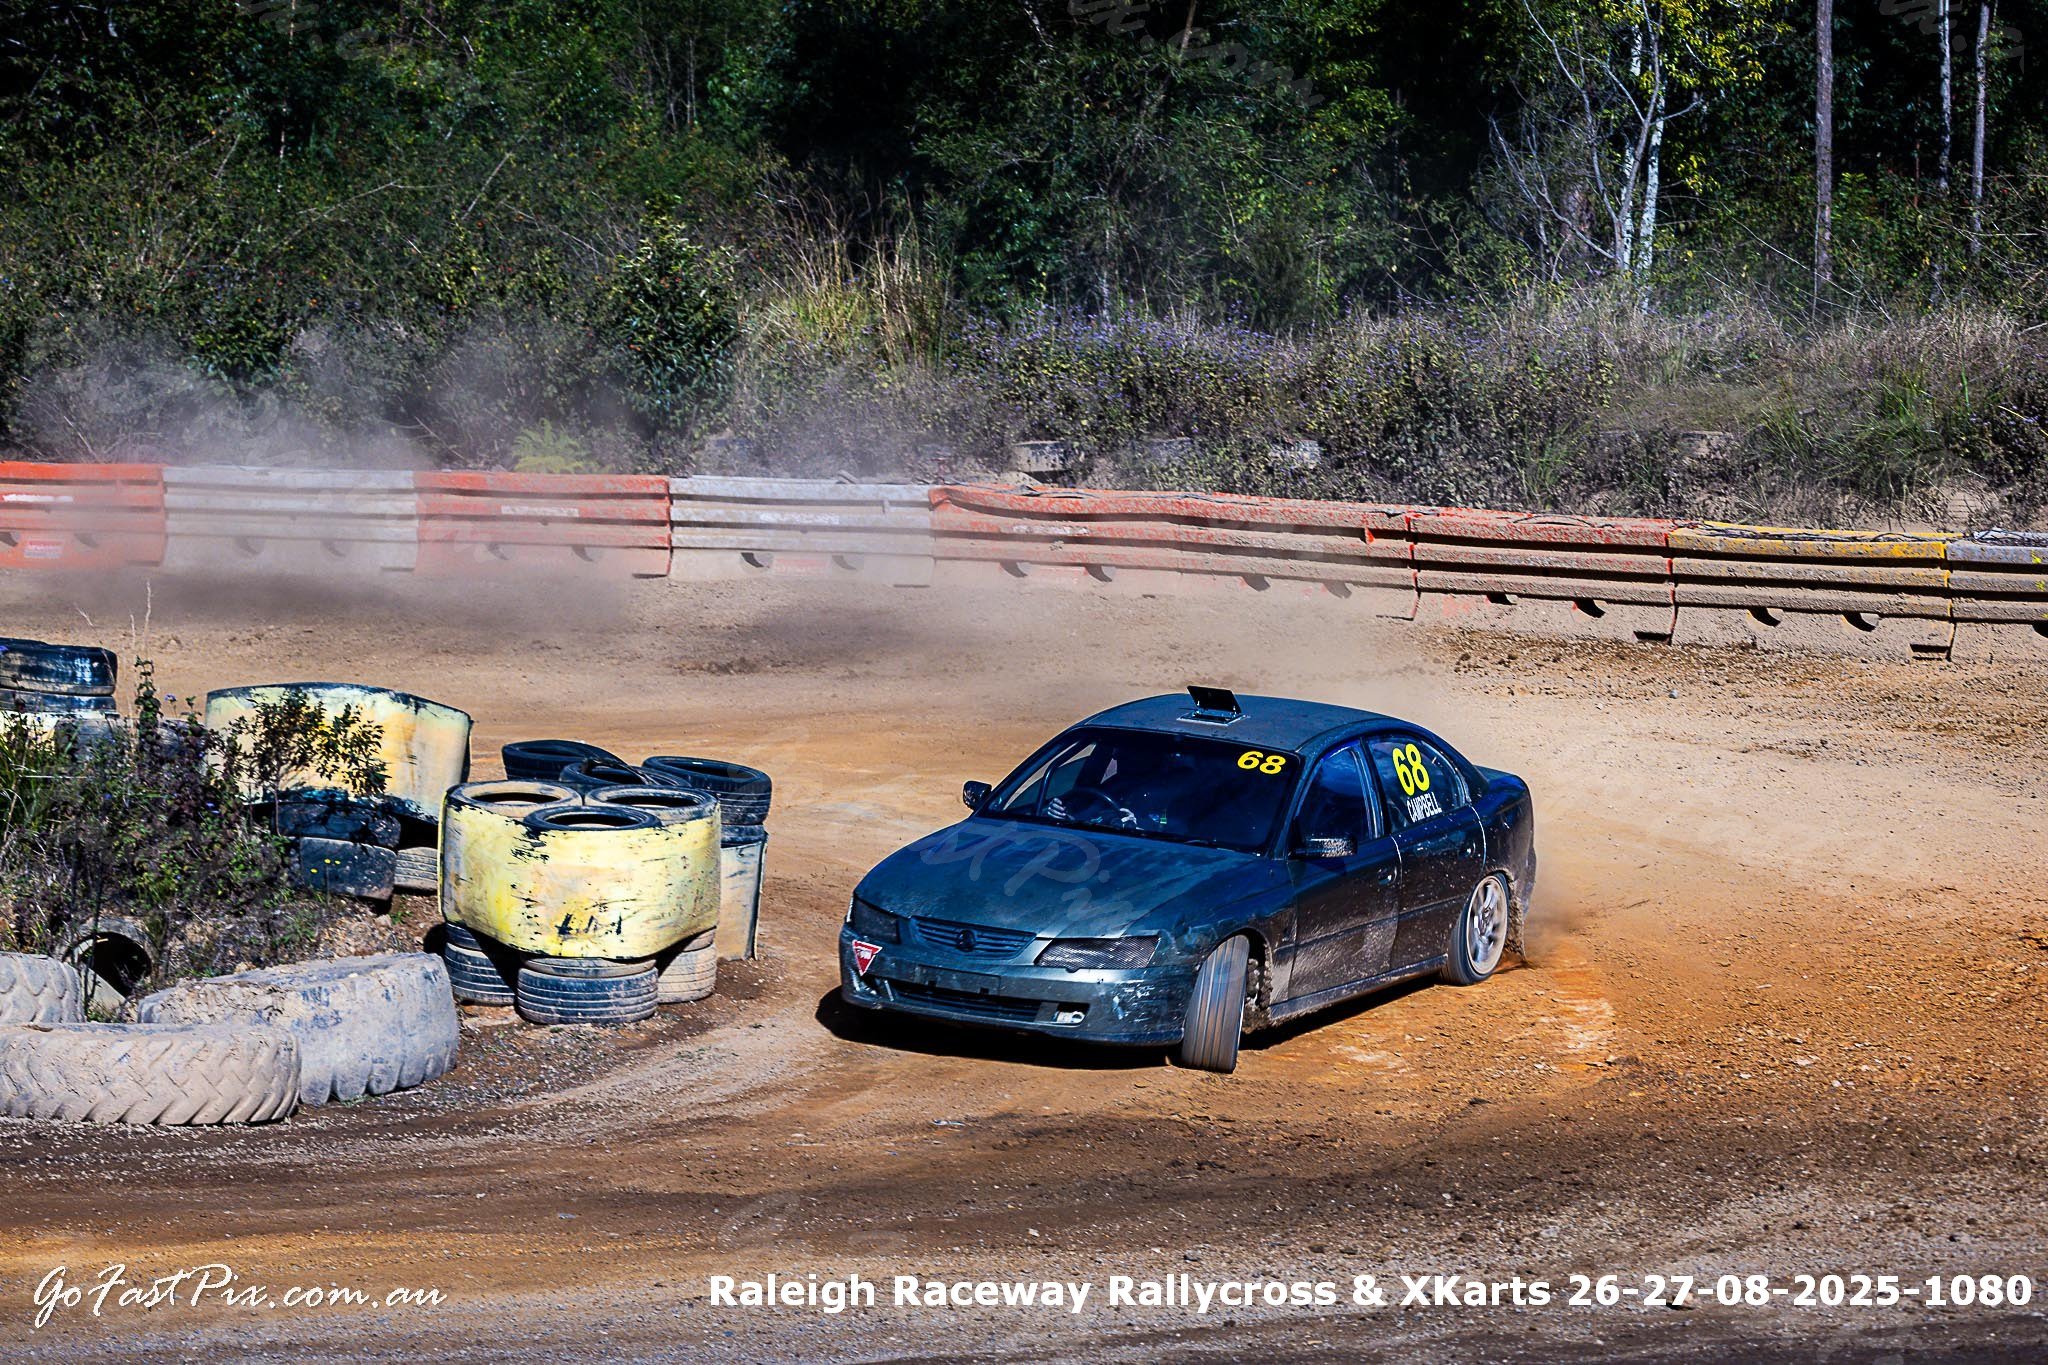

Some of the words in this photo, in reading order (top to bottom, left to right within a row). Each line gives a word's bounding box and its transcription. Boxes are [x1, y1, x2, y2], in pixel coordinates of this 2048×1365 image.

[1237, 751, 1286, 775] 68
[1392, 743, 1431, 796] 68
[1407, 791, 1443, 823] CAMPBELL
